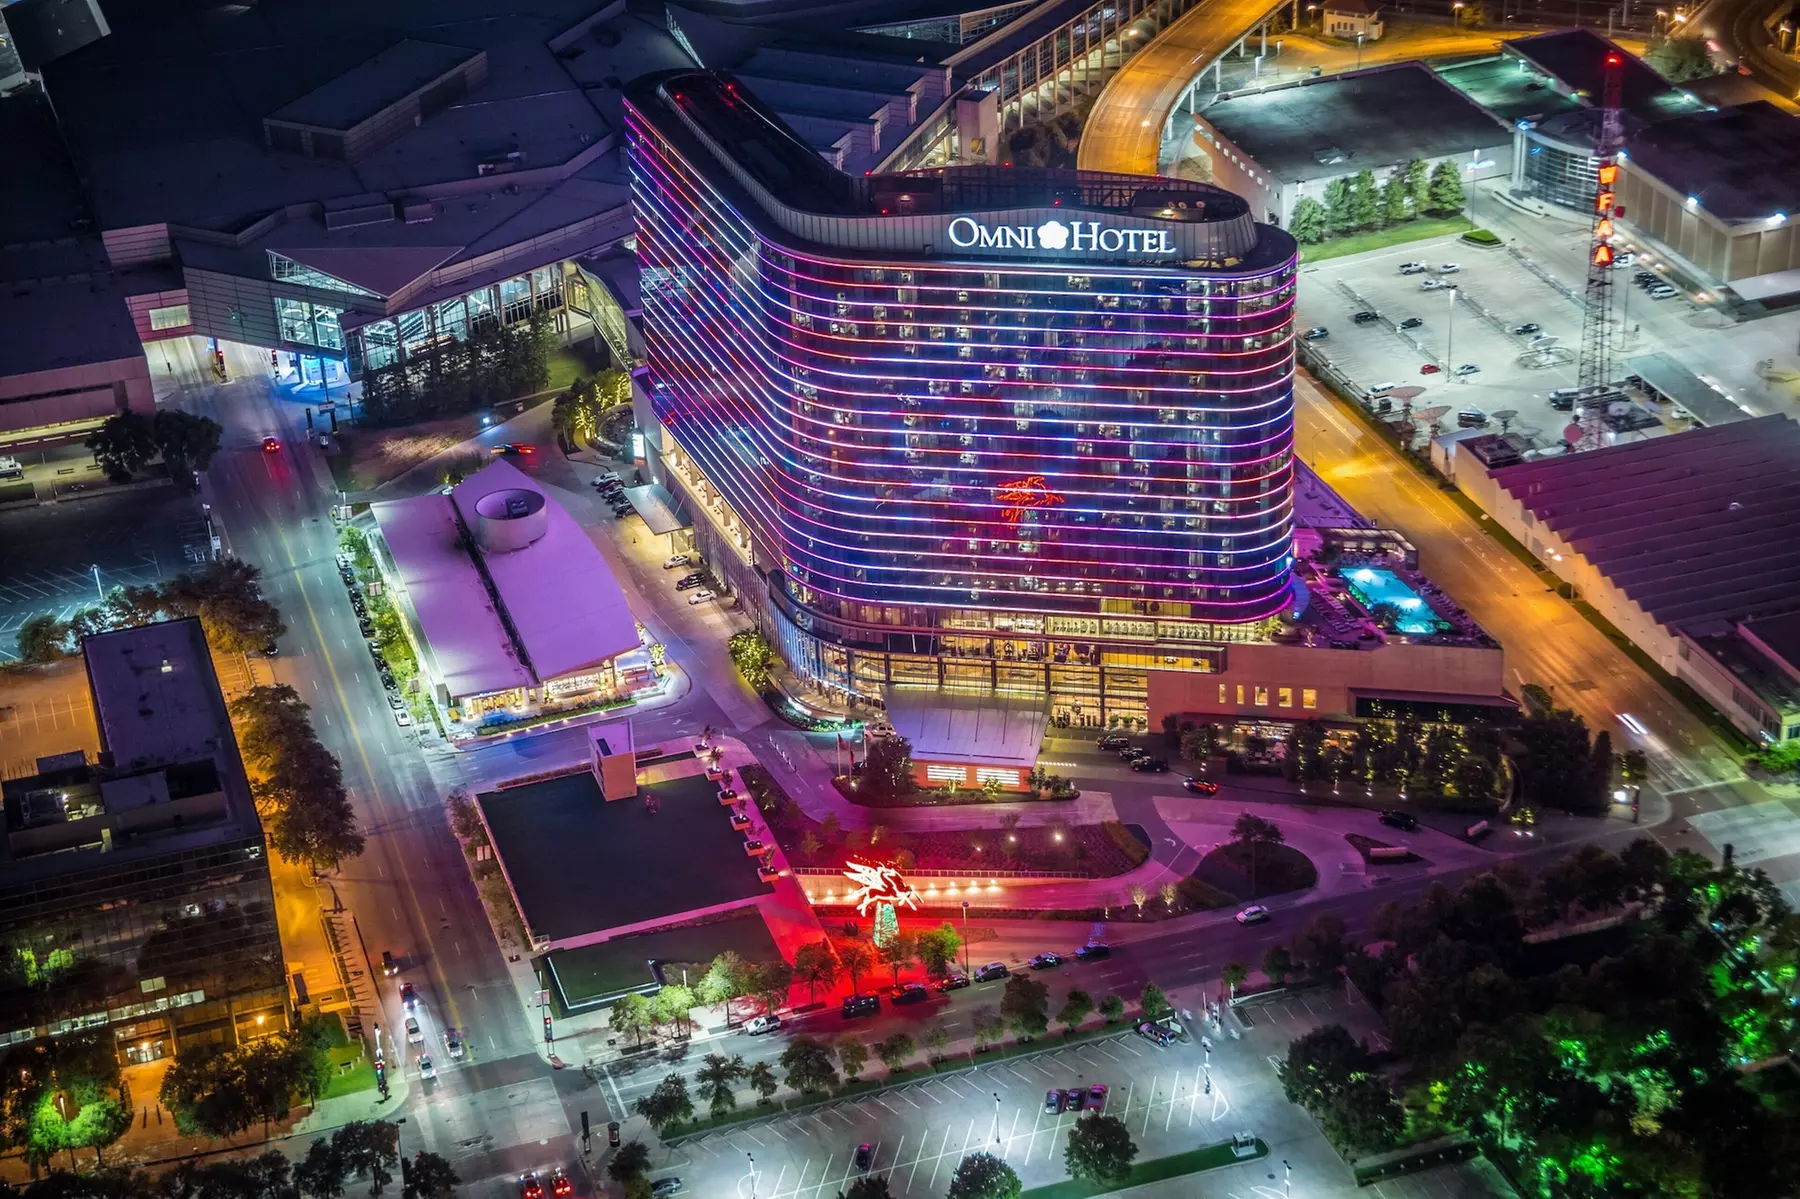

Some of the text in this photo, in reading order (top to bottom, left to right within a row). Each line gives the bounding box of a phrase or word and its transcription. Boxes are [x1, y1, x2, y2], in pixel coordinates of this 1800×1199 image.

[948, 217, 1177, 254] OMNI HOTEL
[1594, 166, 1618, 265] WFAA
